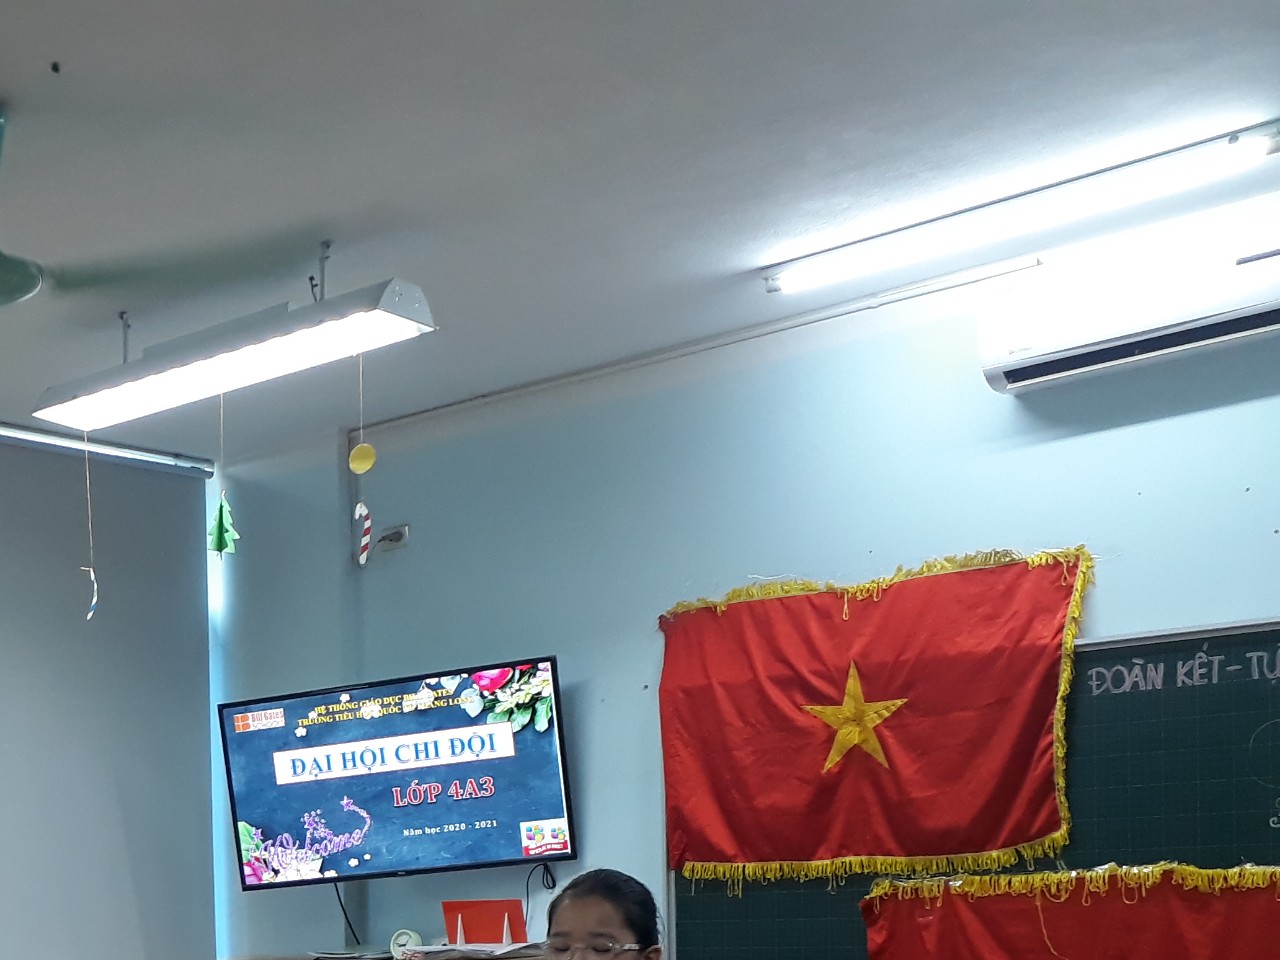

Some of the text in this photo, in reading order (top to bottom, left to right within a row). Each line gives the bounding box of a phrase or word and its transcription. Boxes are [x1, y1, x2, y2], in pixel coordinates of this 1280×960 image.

[1088, 657, 1164, 695] ĐOÀN
[328, 700, 358, 713] THỐNG
[383, 694, 402, 705] DỤC
[290, 732, 498, 778] ĐẠI HỘI CHI ĐỘI
[392, 776, 496, 808] LỚP 4A3
[403, 827, 423, 837] Năm
[425, 825, 441, 836] học
[443, 821, 466, 832] 2020
[474, 819, 498, 830] 2021
